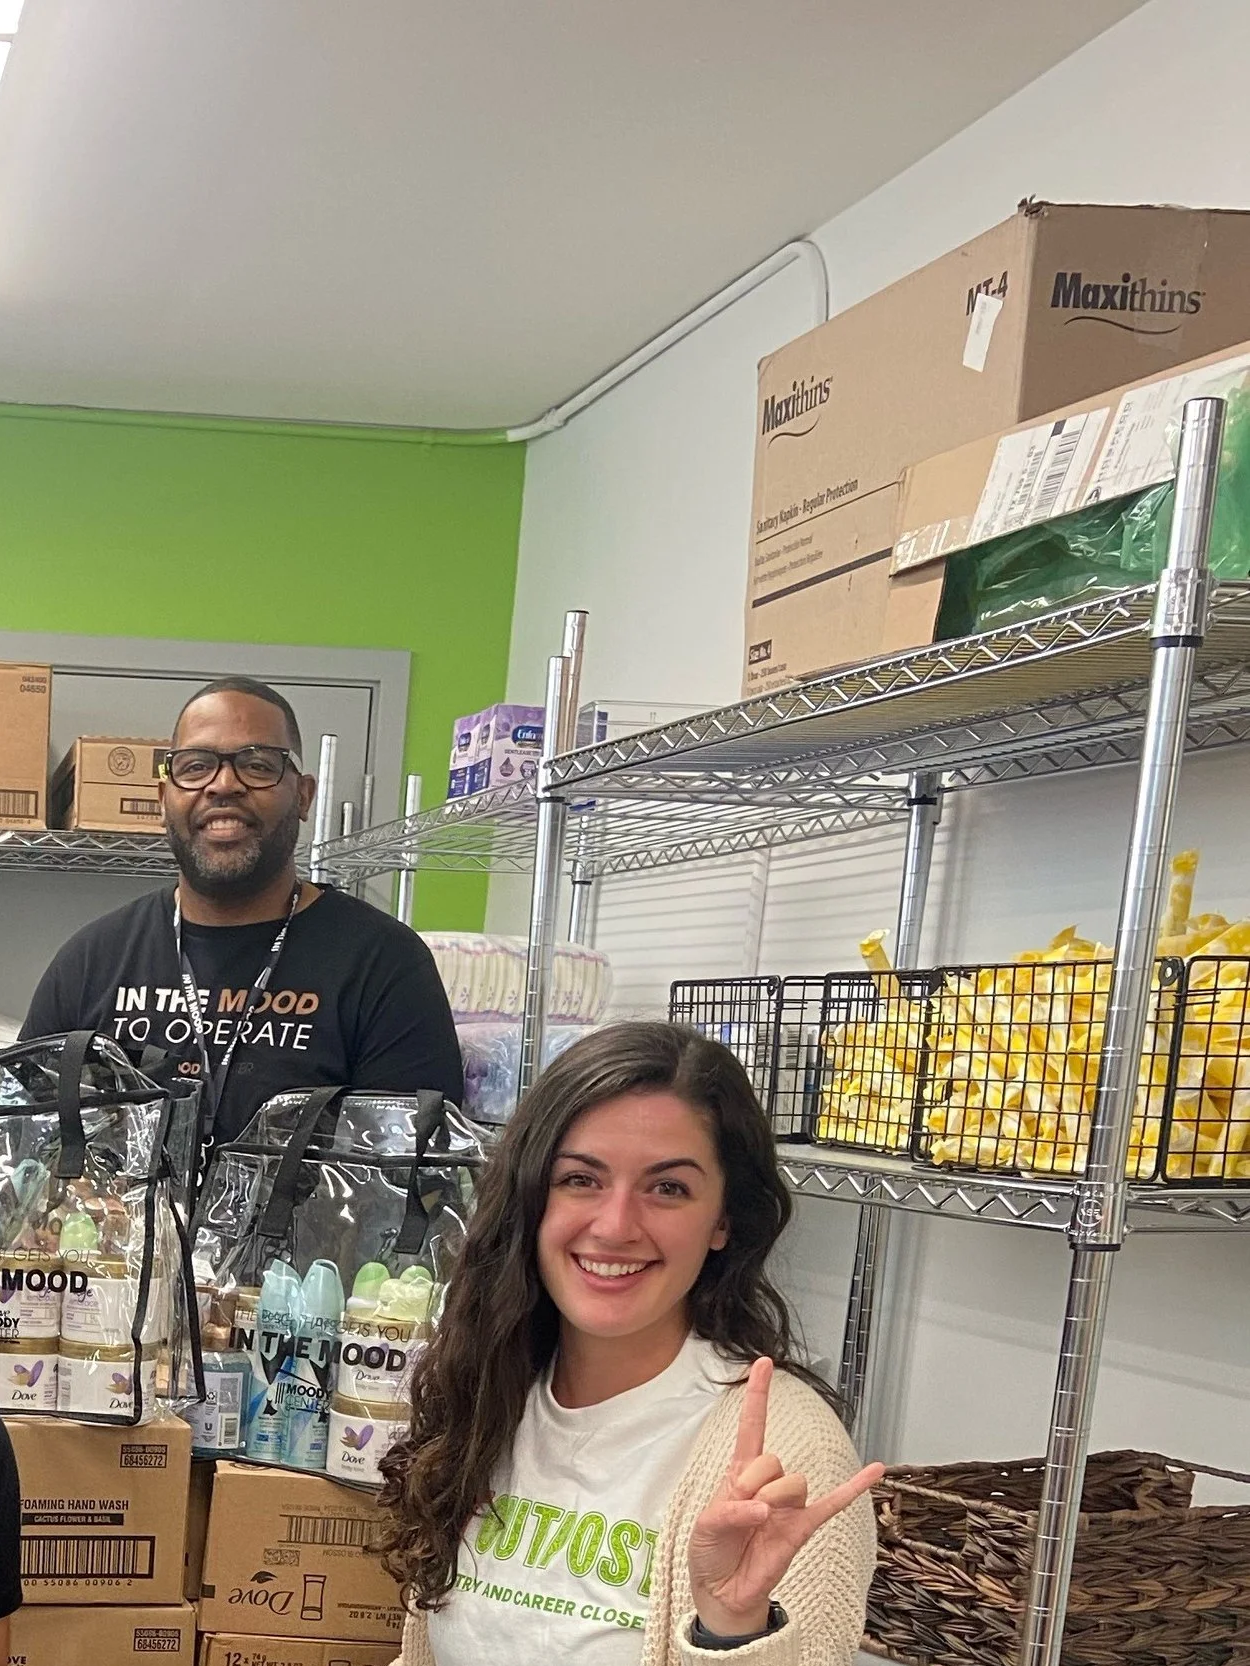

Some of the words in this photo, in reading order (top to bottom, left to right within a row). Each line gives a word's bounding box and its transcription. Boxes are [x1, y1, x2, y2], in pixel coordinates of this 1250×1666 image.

[1051, 272, 1201, 314] Maxithins
[762, 376, 830, 435] Maxithins
[780, 505, 799, 526] Napkin
[826, 478, 858, 505] Protection
[115, 986, 147, 1011] IN
[155, 987, 210, 1014] THE
[114, 1017, 150, 1042] TO
[165, 1018, 313, 1050] OPERATE
[13, 1246, 51, 1262] GETS
[55, 1249, 92, 1264] YOU
[1, 1268, 88, 1293] MOOD
[377, 1324, 411, 1343] YOU
[229, 1327, 253, 1351] IN
[261, 1331, 312, 1358] THE
[319, 1338, 407, 1371] MOOD
[12, 1389, 37, 1401] Dove
[285, 1383, 332, 1399] MOODY
[109, 1398, 134, 1409] Dove
[124, 1455, 163, 1466] 68456272
[341, 1451, 366, 1464] Dove
[20, 1499, 65, 1510] FOAMING
[67, 1500, 96, 1510] HAND
[99, 1500, 129, 1511] WASH
[34, 1515, 59, 1523] CACTUS
[60, 1515, 88, 1523] FLOWER
[85, 1579, 121, 1587] 00906
[228, 1587, 295, 1616] Dove
[456, 1574, 483, 1593] TRY
[482, 1582, 513, 1603] AND
[514, 1591, 577, 1617] CAREER
[580, 1604, 647, 1630] CLOSE
[137, 1639, 177, 1650] 68456272
[7, 1656, 27, 1664] VE
[224, 1652, 242, 1666] 12
